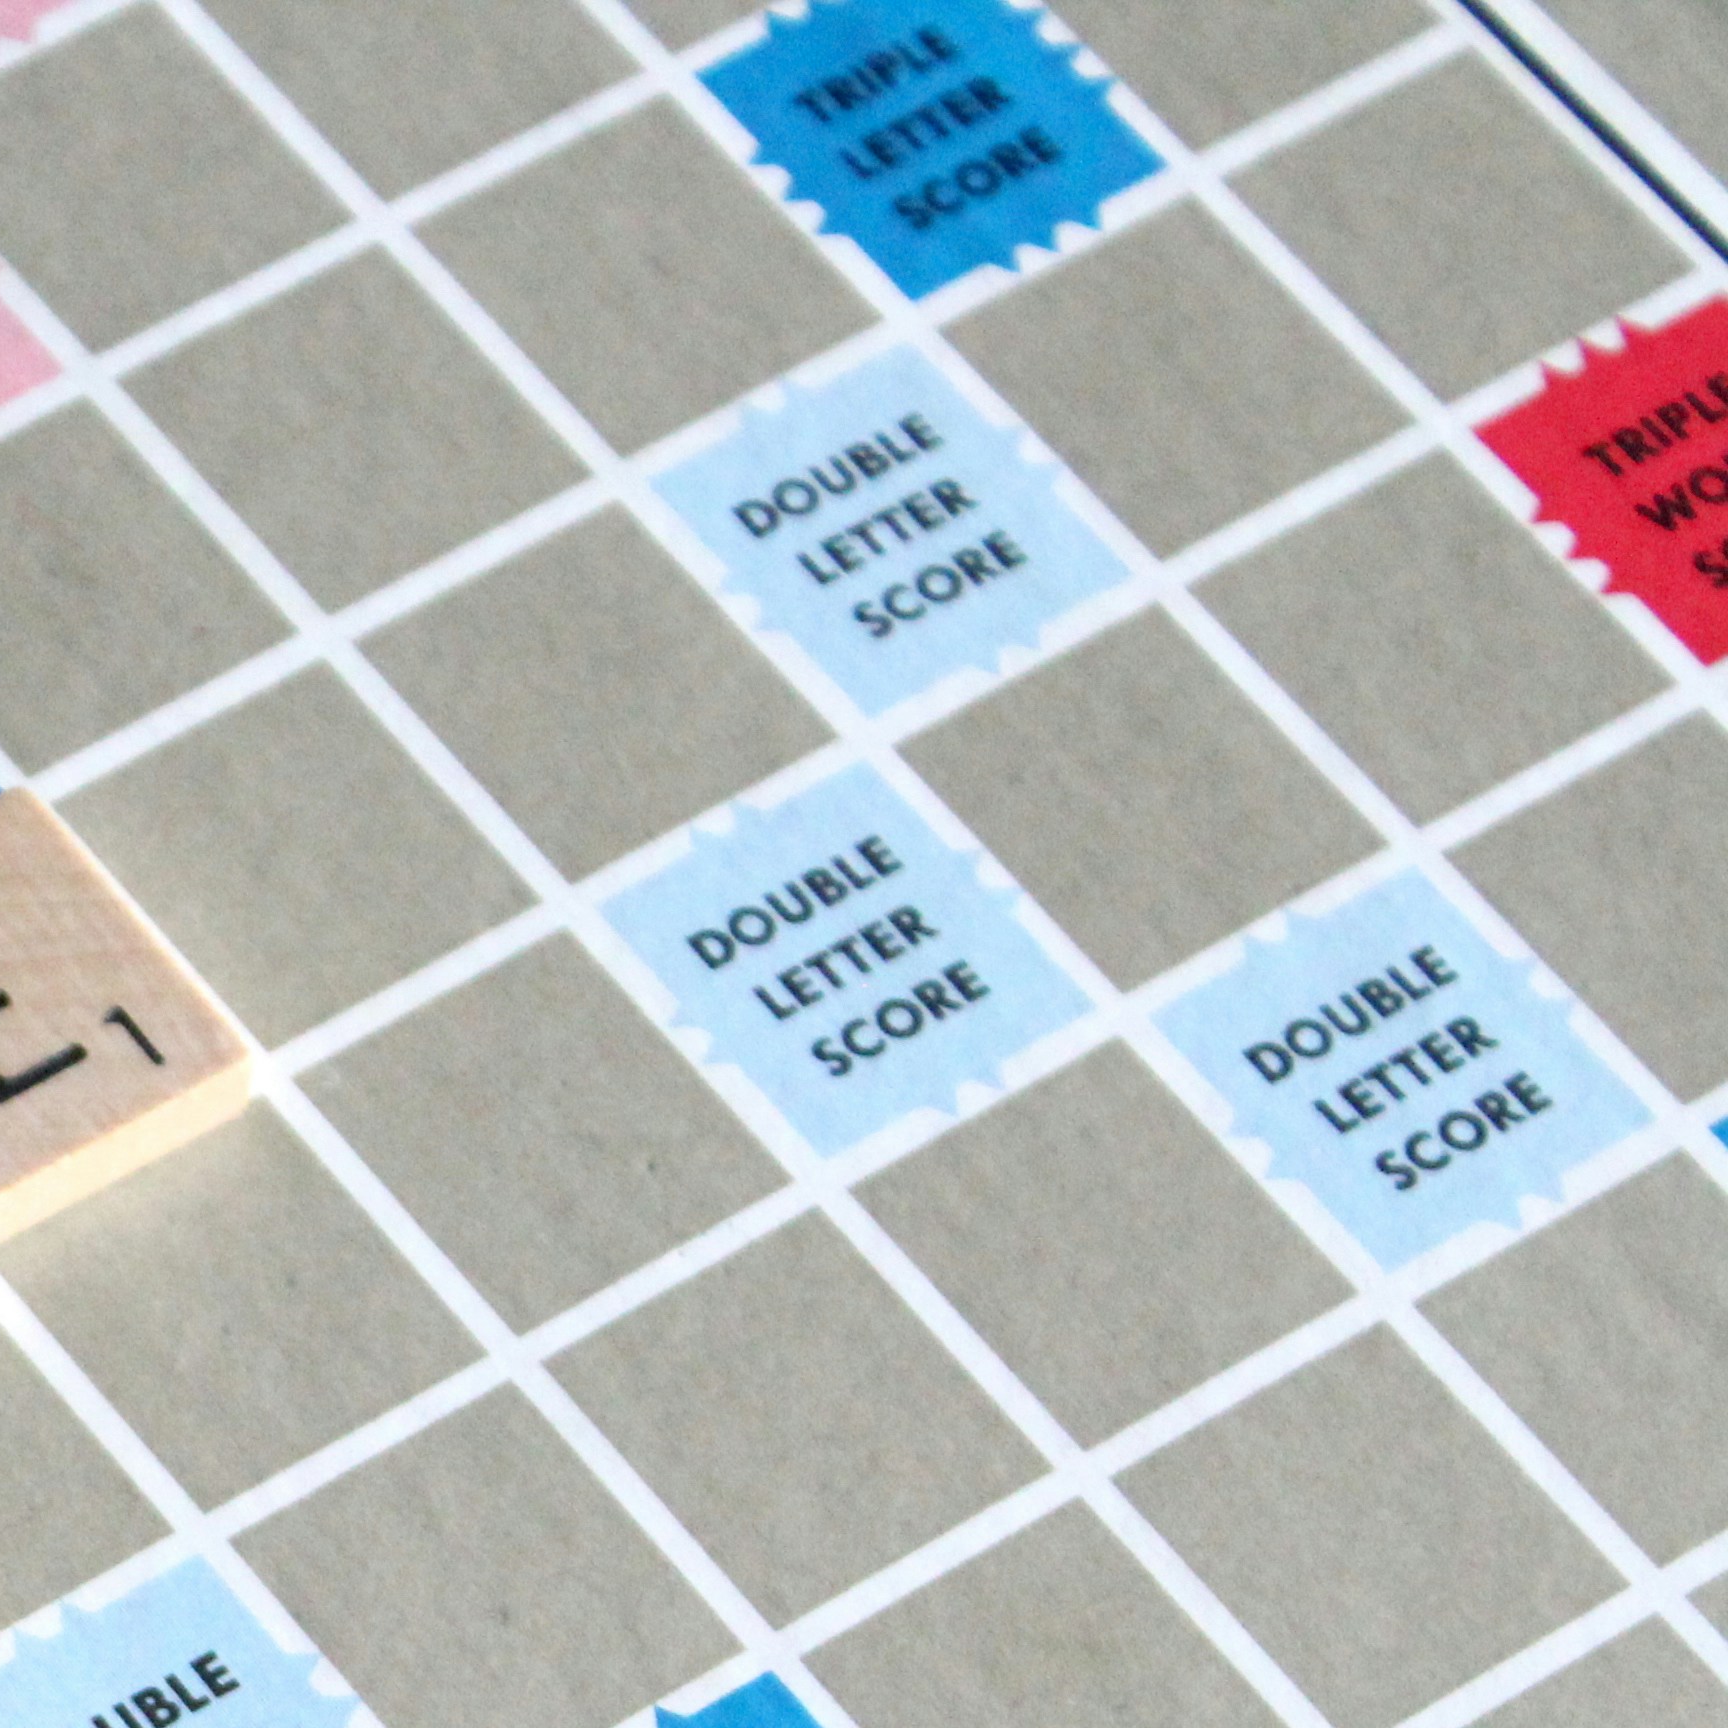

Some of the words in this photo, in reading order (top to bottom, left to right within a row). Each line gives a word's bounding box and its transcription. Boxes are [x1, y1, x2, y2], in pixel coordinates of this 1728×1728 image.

[793, 27, 958, 125] TRIPLE
[843, 75, 1012, 182] LETTER
[891, 126, 1063, 233] SCORE
[732, 414, 941, 541] DOUBLE
[797, 477, 976, 588] LETTER
[1634, 453, 1728, 531] WO
[852, 529, 1028, 641] SCORE
[687, 836, 902, 971] DOUBLE
[755, 906, 937, 1021] LETTER
[811, 961, 989, 1077] SCORE
[1243, 946, 1457, 1085] DOUBLE
[103, 1006, 166, 1066] 1
[1314, 1017, 1498, 1135] LETTER
[1375, 1072, 1553, 1192] SCORE
